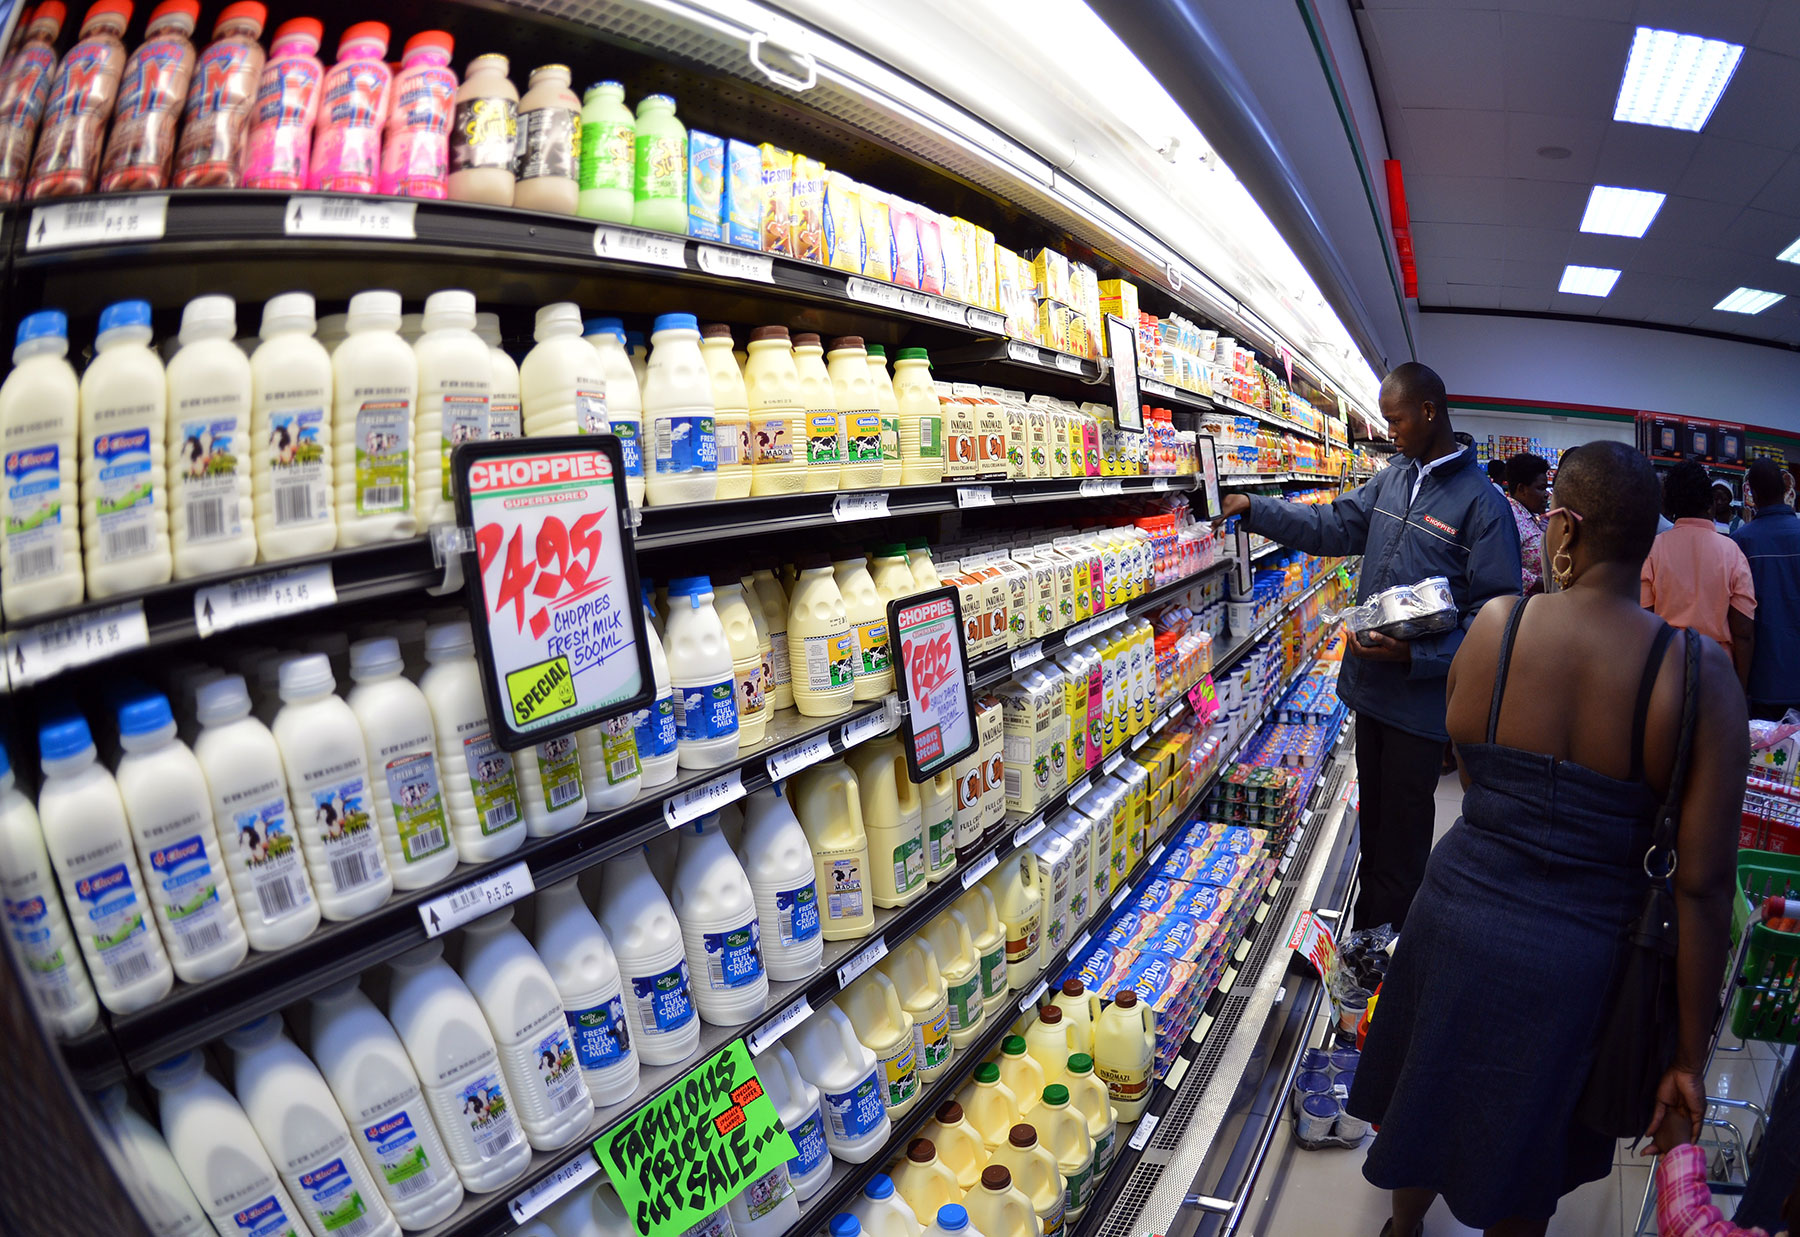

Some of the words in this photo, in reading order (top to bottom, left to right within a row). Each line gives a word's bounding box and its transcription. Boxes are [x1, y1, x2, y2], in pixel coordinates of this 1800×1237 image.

[766, 448, 793, 456] MADILA
[883, 444, 897, 452] DILA
[468, 454, 613, 489] CHOPPIES
[505, 491, 587, 508] SUPERSTORES
[1425, 515, 1457, 535] CHOPPIES
[274, 584, 311, 606] P:5.45
[554, 594, 610, 633] CHOPPIES
[898, 600, 954, 628] CHOPPIES
[961, 600, 980, 613] NKOMAZI
[548, 626, 590, 657] FRESH
[593, 610, 623, 638] MILK
[574, 632, 622, 666] 500ML
[516, 661, 568, 719] SPECIAL
[575, 705, 598, 717] YOUR
[713, 698, 732, 709] FRESH
[717, 707, 731, 716] FULL
[711, 711, 735, 723] CREAM
[717, 718, 733, 728] MILK
[915, 730, 938, 749] TODAYS
[916, 741, 939, 761] SPECIAL
[709, 782, 729, 799] P:6.95
[960, 819, 972, 832] FULL
[167, 843, 199, 862] Clover
[92, 872, 123, 890] Clover
[486, 882, 514, 904] P:5.25
[799, 901, 815, 913] FRESH
[801, 908, 814, 919] FULL
[796, 911, 817, 926] CREAM
[801, 920, 816, 930] MILK
[1291, 913, 1310, 945] CHOPPIES
[730, 945, 751, 958] FRESH
[733, 953, 750, 964] FULL
[728, 956, 756, 971] CREAM
[734, 963, 753, 976] MILK
[660, 987, 682, 1002] FRESH
[664, 995, 681, 1007] FULL
[660, 998, 688, 1015] CREAM
[667, 1007, 685, 1020] MILK
[583, 1025, 609, 1038] FRESH
[587, 1033, 609, 1045] FULL
[582, 1037, 616, 1052] CREAM
[589, 1046, 612, 1057] MILK
[1101, 1069, 1130, 1080] INKOMAZI
[735, 1084, 752, 1100] SPECIAL
[743, 1088, 757, 1101] OFFER
[857, 1089, 877, 1108] FRESH
[857, 1099, 881, 1122] CREAM
[861, 1098, 877, 1113] FULL
[610, 1050, 736, 1179] FABULOUS
[863, 1110, 880, 1126] MILK
[379, 1117, 405, 1133] Clover
[799, 1128, 819, 1147] FRESH
[803, 1138, 818, 1153] FULL
[639, 1109, 713, 1197] PRICE
[798, 1138, 823, 1161] CREAM
[804, 1149, 821, 1165] MILK
[314, 1164, 340, 1181] Clover
[557, 1161, 583, 1184] P:12.95
[248, 1201, 274, 1218] Clover
